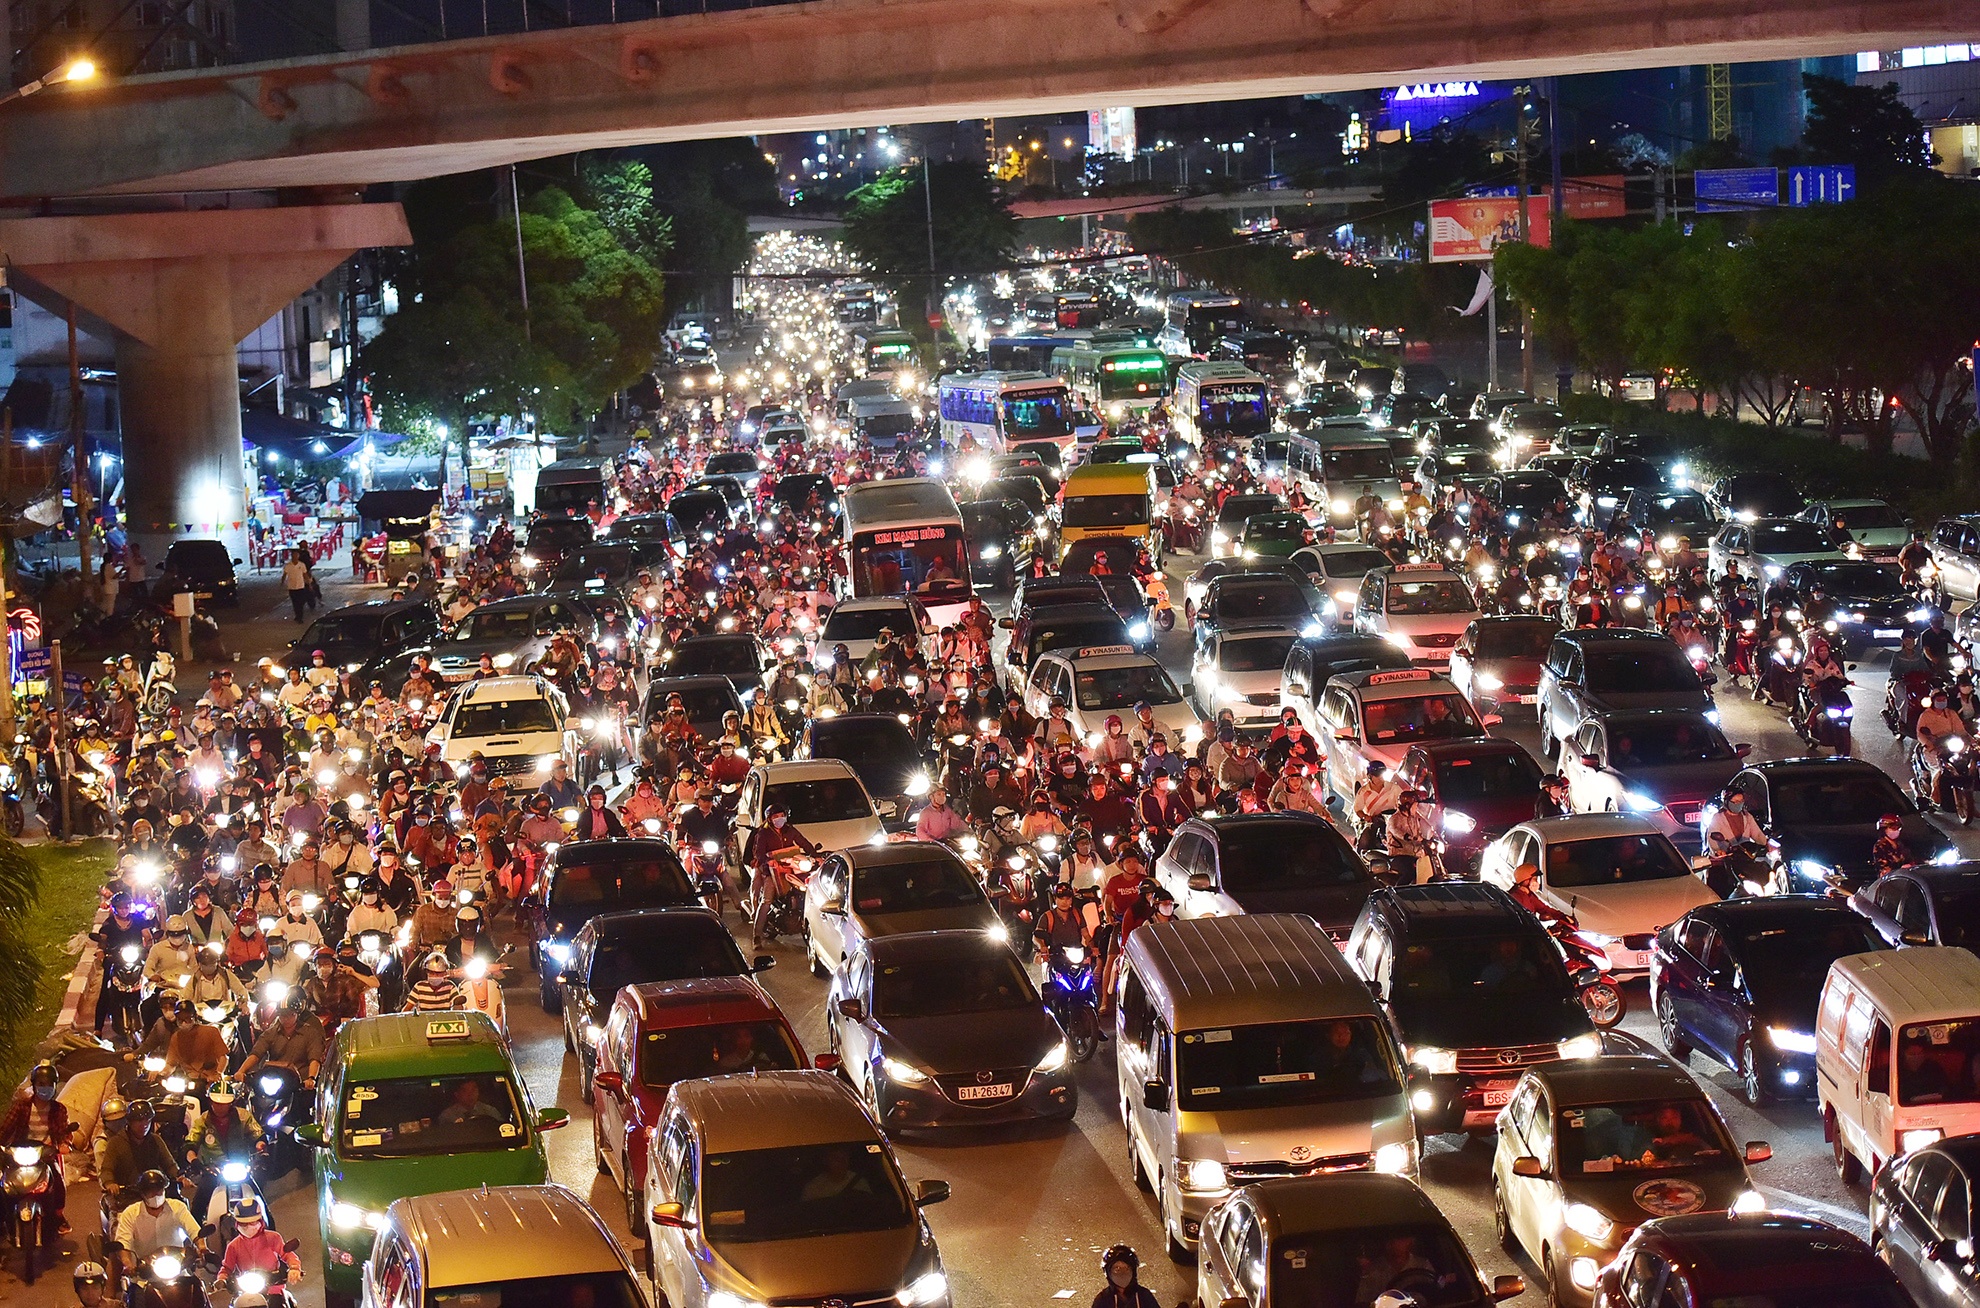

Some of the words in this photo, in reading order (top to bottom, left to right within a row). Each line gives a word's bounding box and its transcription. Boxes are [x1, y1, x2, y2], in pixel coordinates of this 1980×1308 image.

[1412, 82, 1479, 98] ALASKA
[874, 532, 892, 544] KIM
[893, 530, 919, 543] MẠNH
[1092, 646, 1121, 655] VINASUN
[1383, 672, 1414, 681] VINASUN
[960, 1084, 1011, 1099] 61A-263.47
